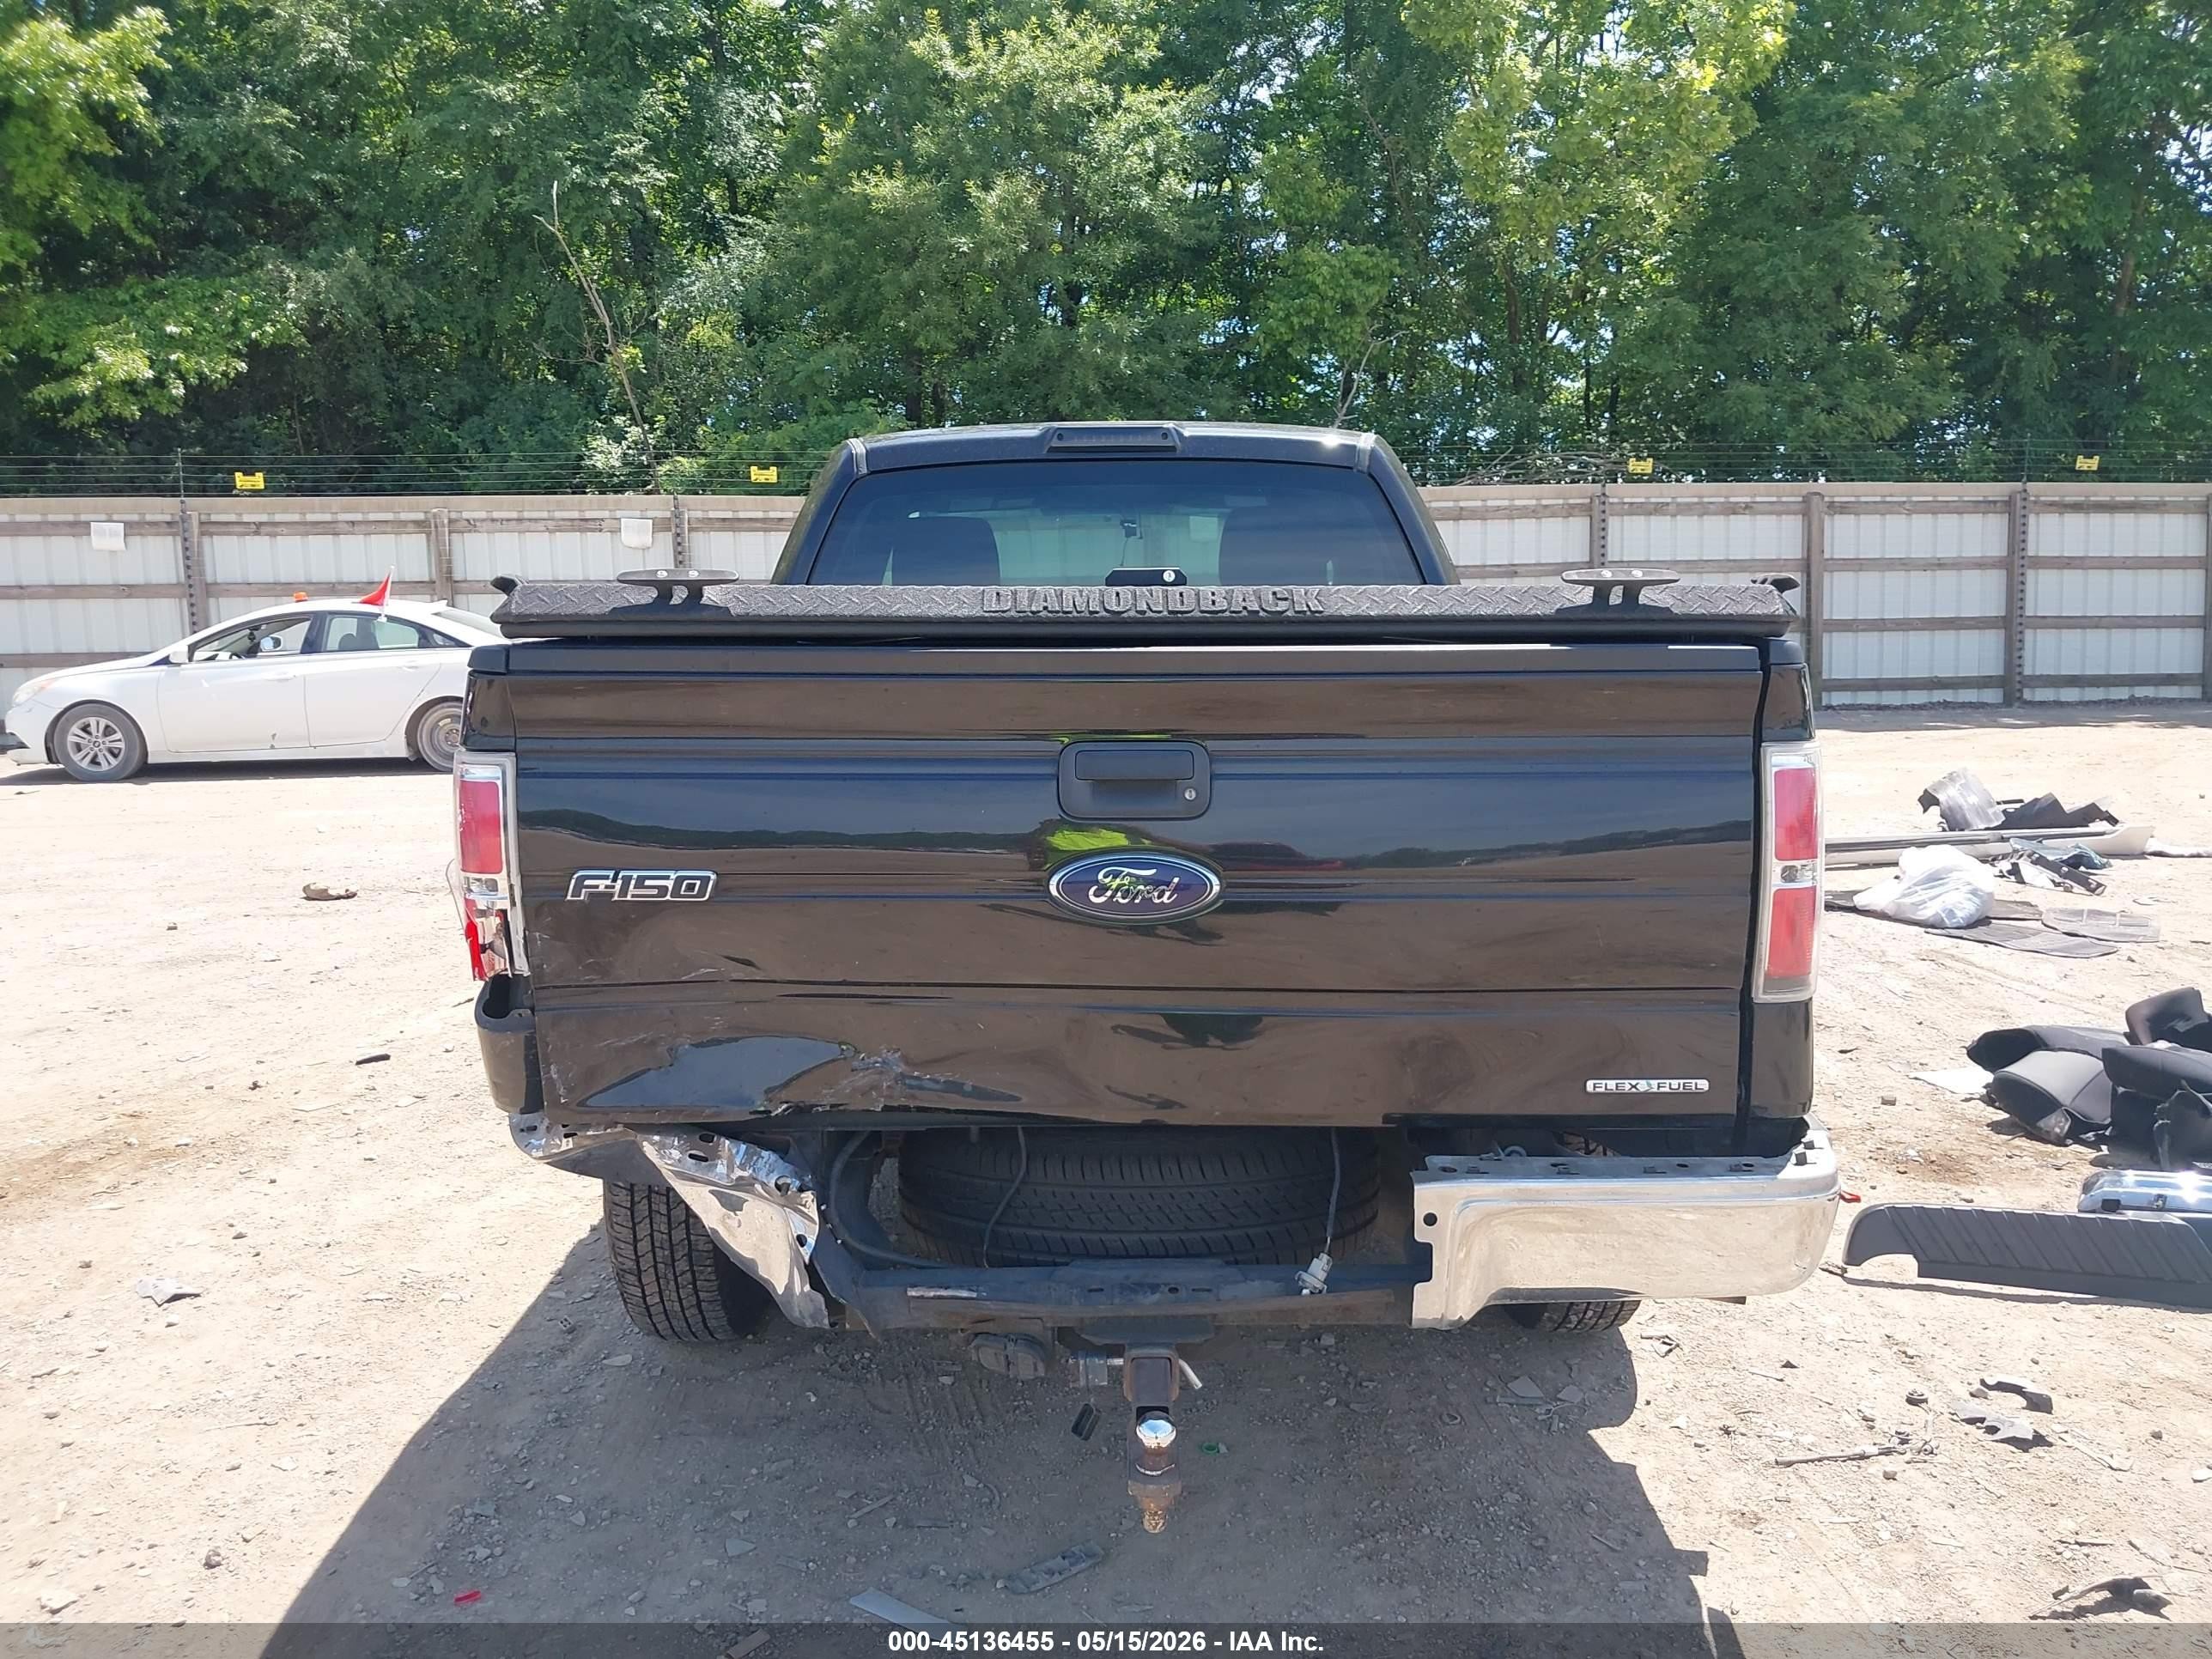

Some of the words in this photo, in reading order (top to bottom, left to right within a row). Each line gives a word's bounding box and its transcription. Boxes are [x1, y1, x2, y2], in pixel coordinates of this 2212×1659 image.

[983, 586, 1324, 614] DIAMONDBACK
[565, 869, 718, 902] F-150
[1088, 866, 1182, 904] Ford
[1592, 1082, 1641, 1091] FLEX
[1656, 1081, 1705, 1091] FUEL
